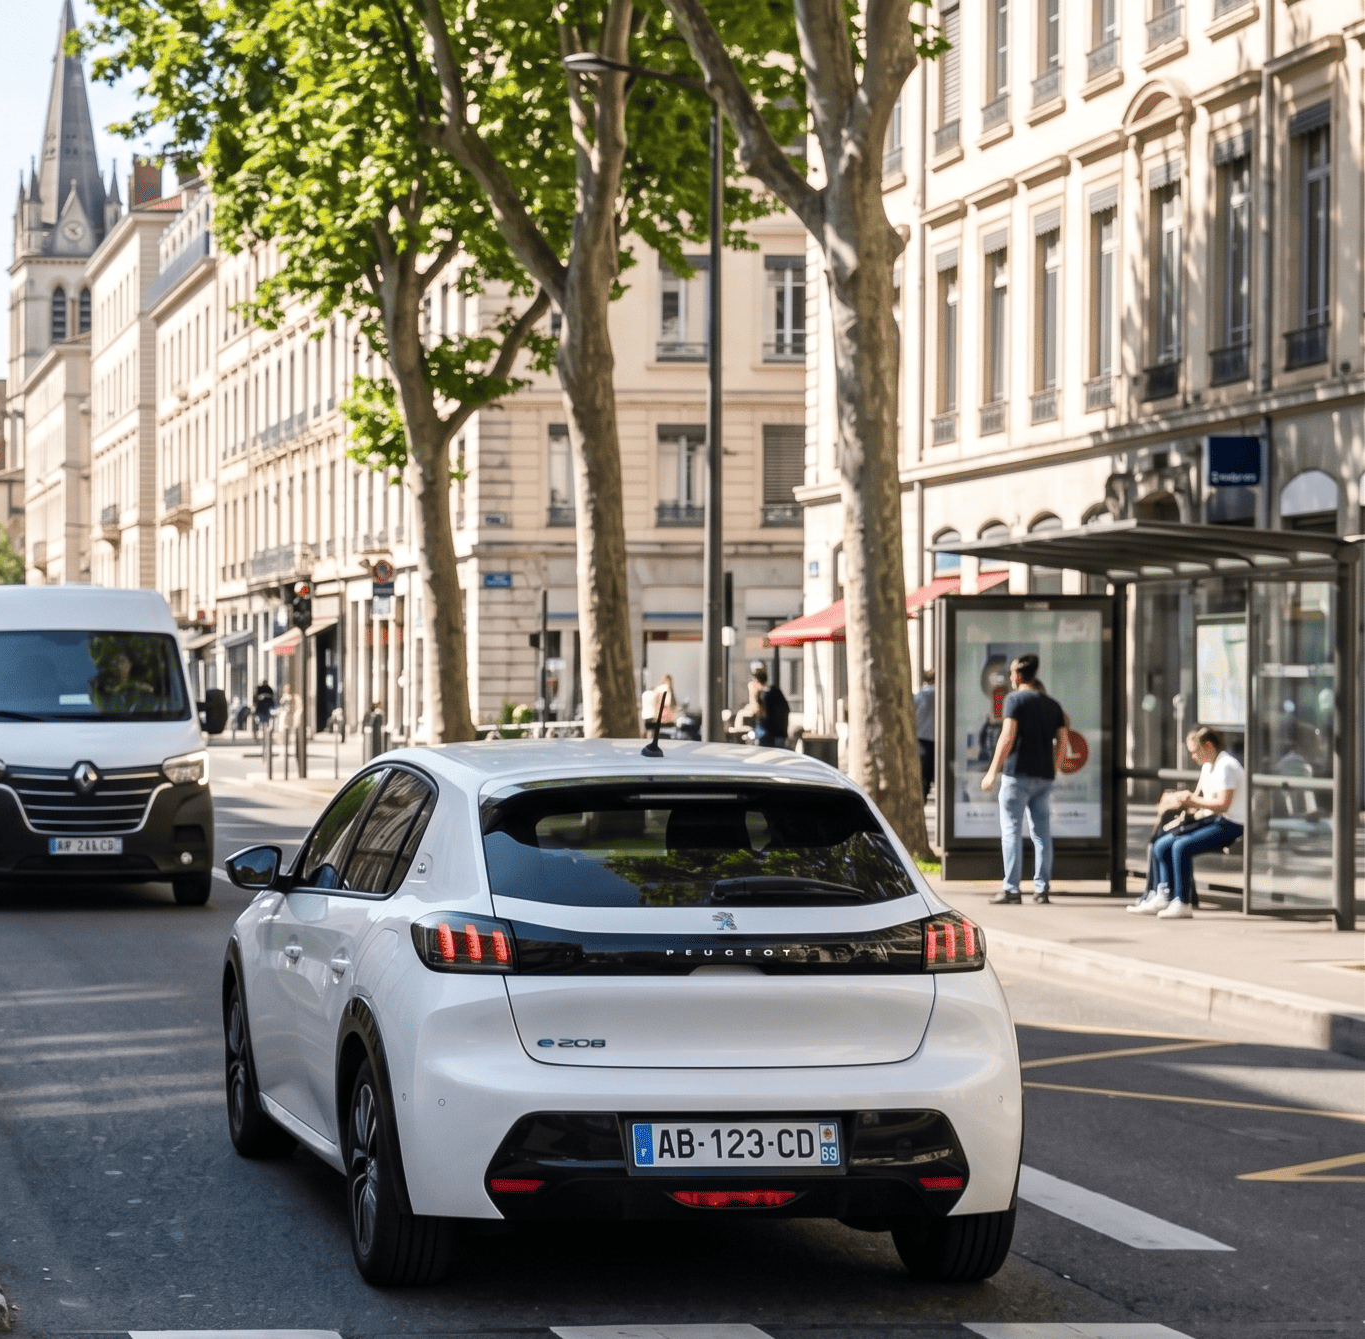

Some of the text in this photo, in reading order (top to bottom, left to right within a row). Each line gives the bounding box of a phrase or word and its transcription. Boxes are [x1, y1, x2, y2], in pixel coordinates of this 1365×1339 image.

[557, 1038, 606, 1048] 208
[658, 1128, 815, 1159] AB-123-CD
[822, 1146, 837, 1161] 69
